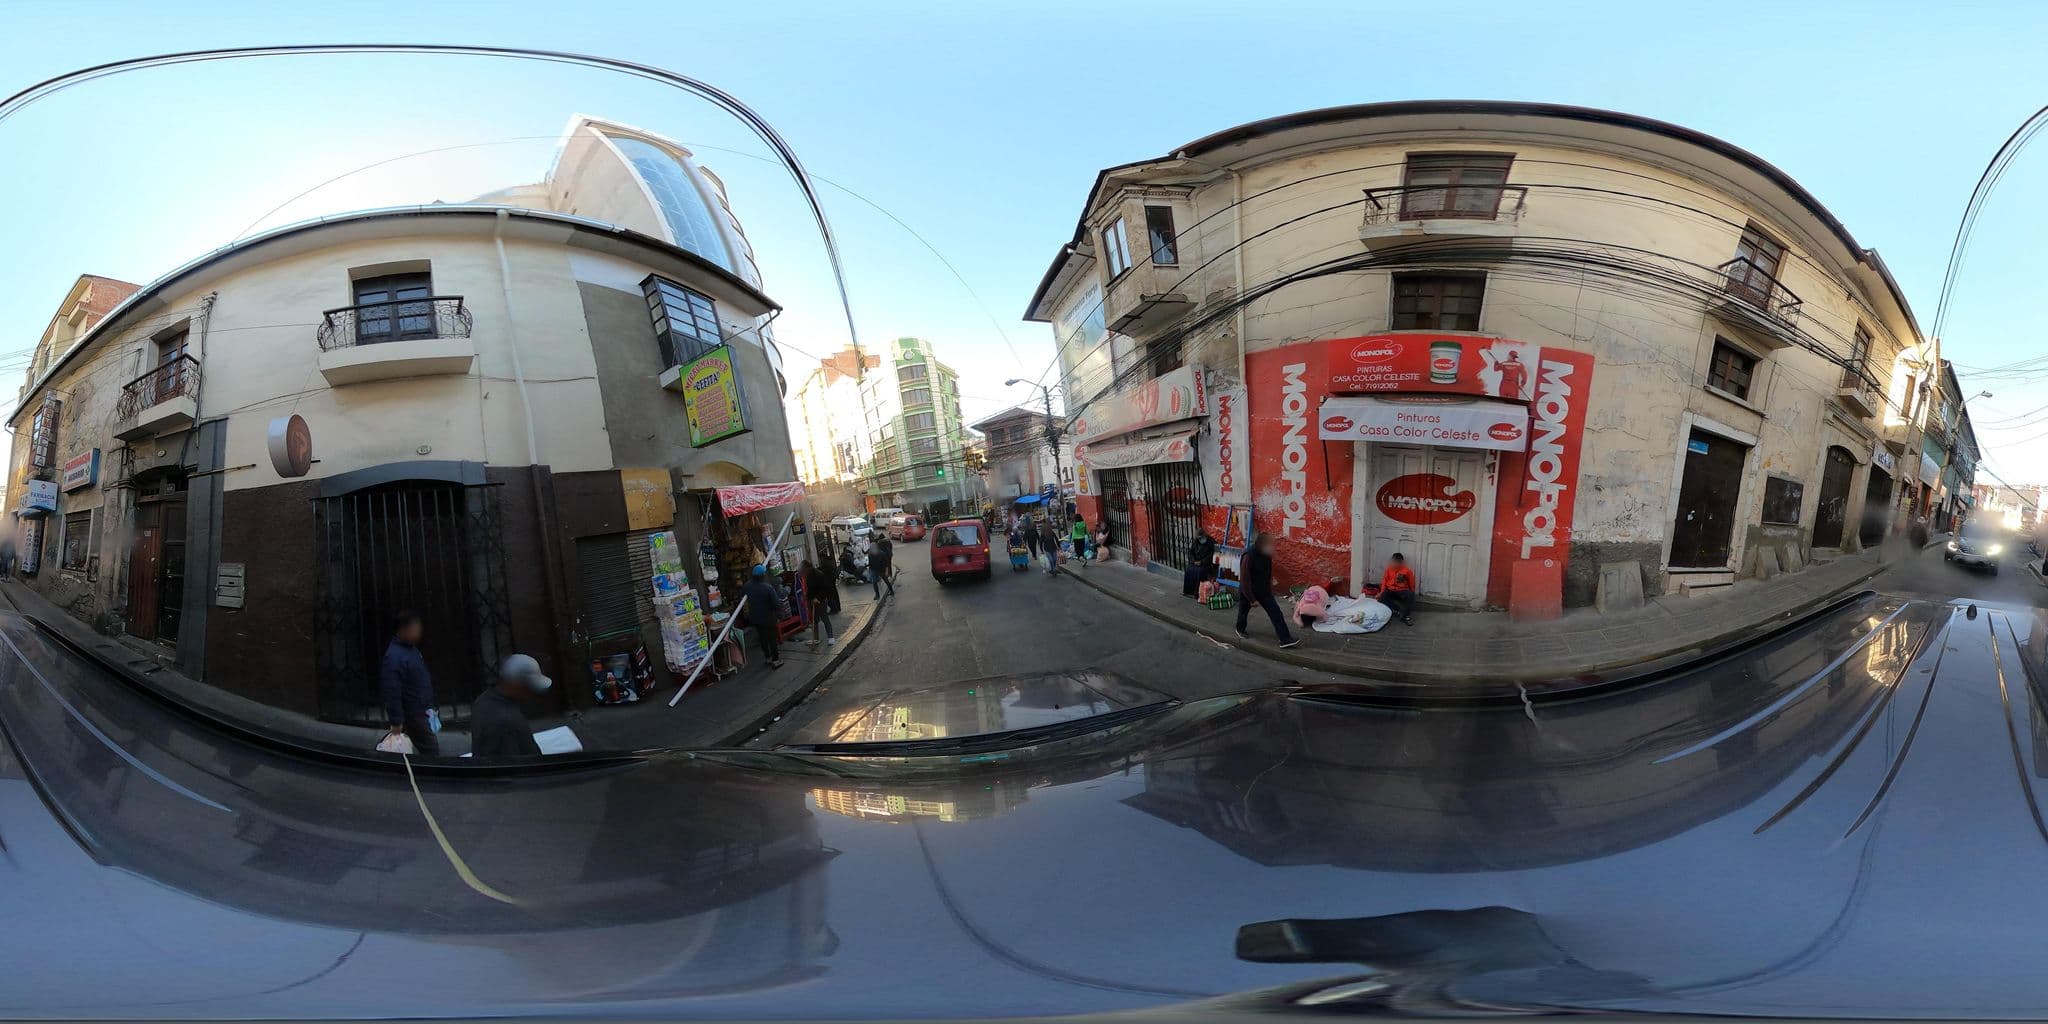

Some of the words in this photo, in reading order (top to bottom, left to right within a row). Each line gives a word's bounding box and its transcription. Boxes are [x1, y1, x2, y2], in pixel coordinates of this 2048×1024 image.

[1357, 349, 1394, 358] MONOPOL
[1357, 365, 1393, 373] PINTURAS
[1333, 375, 1351, 383] CASA
[1352, 374, 1381, 382] COLOR
[1383, 373, 1420, 381] CELESTE
[1397, 412, 1441, 424] Pinturas
[1359, 424, 1390, 436] Casa
[1393, 425, 1428, 438] Color
[1431, 427, 1480, 441] Celeste
[1491, 429, 1518, 438] MONOPOL
[1218, 395, 1233, 497] MONOPOL
[1282, 363, 1307, 539] MONOPOL
[1521, 360, 1574, 559] MONOPOL
[1388, 495, 1460, 514] MONOPOL
